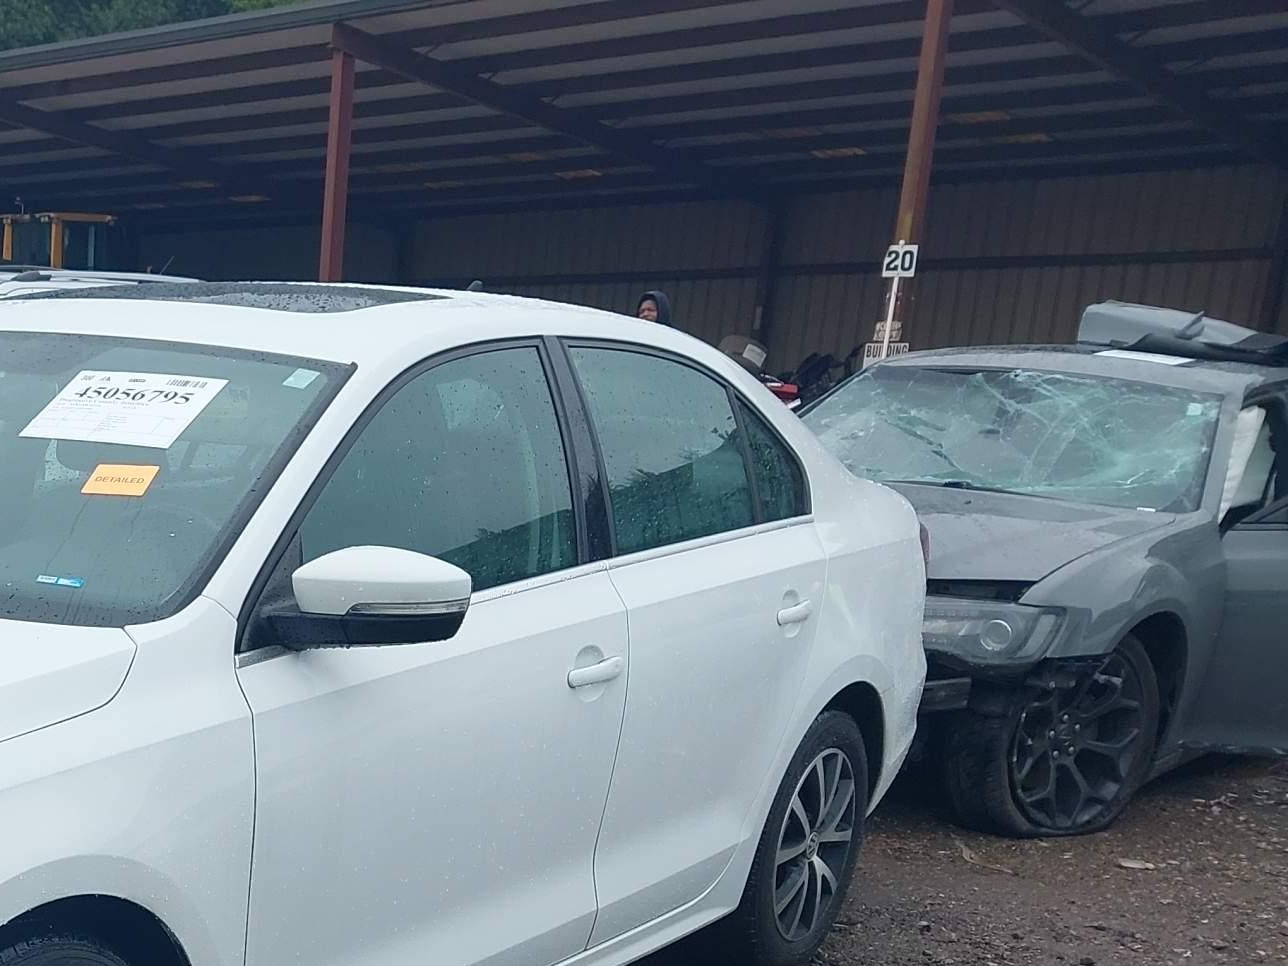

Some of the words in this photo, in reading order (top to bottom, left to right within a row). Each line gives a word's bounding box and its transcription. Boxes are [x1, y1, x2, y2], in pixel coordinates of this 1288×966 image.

[884, 250, 915, 272] 20
[865, 343, 910, 359] BUIDING
[74, 385, 196, 405] 45056795
[94, 475, 145, 485] DETAILED
